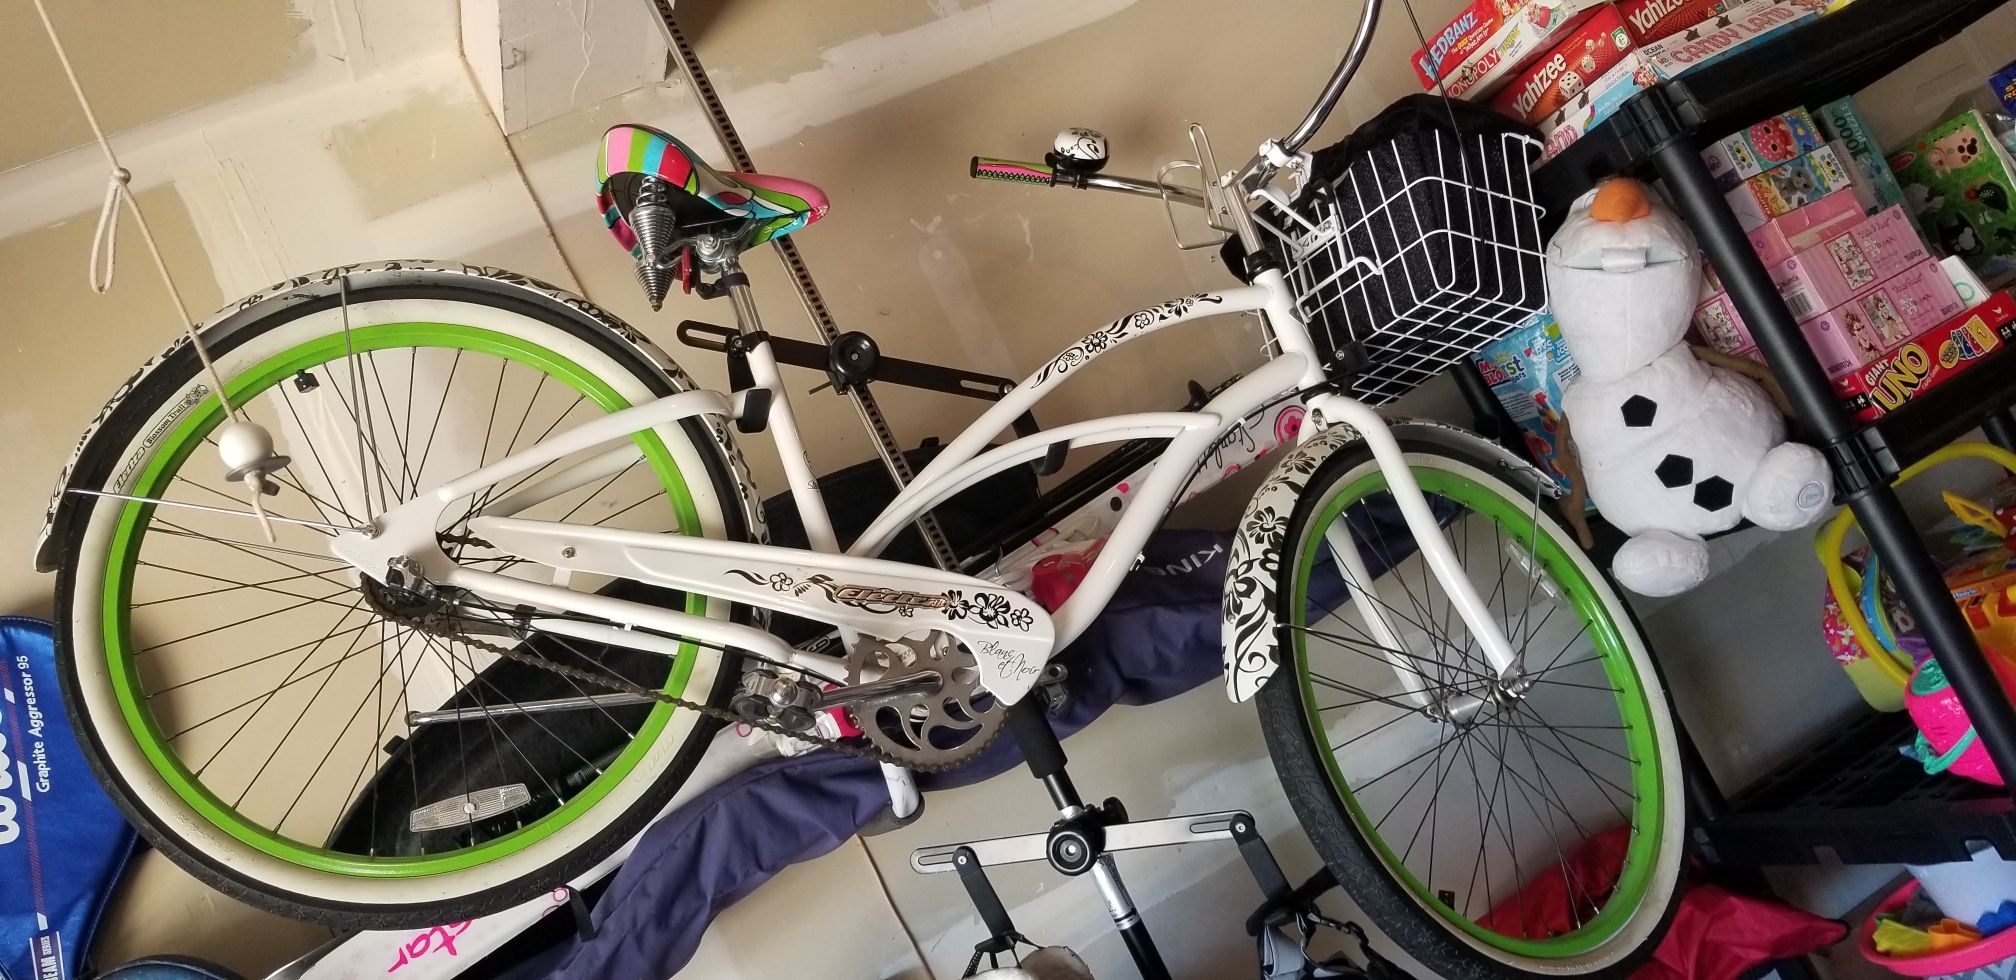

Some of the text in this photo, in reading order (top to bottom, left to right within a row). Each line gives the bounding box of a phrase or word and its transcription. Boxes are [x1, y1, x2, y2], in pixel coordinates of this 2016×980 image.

[1419, 11, 1478, 81] HEDBANZ
[1643, 44, 1664, 56] OCEAN
[1670, 28, 1742, 63] CANDY
[1737, 7, 1795, 34] LAND
[1512, 53, 1567, 119] Yahtzee
[1834, 116, 1872, 161] 1000
[1839, 103, 1867, 143] PUZZLE
[1864, 358, 1890, 387] GIANT
[1870, 341, 1930, 411] UNO
[146, 420, 171, 445] Blossom
[168, 404, 186, 420] Trail
[977, 640, 1015, 660] Blanc
[1011, 653, 1040, 681] Noir
[16, 654, 50, 794] Graphite Aggressor 95
[41, 935, 59, 980] EAM SERIES
